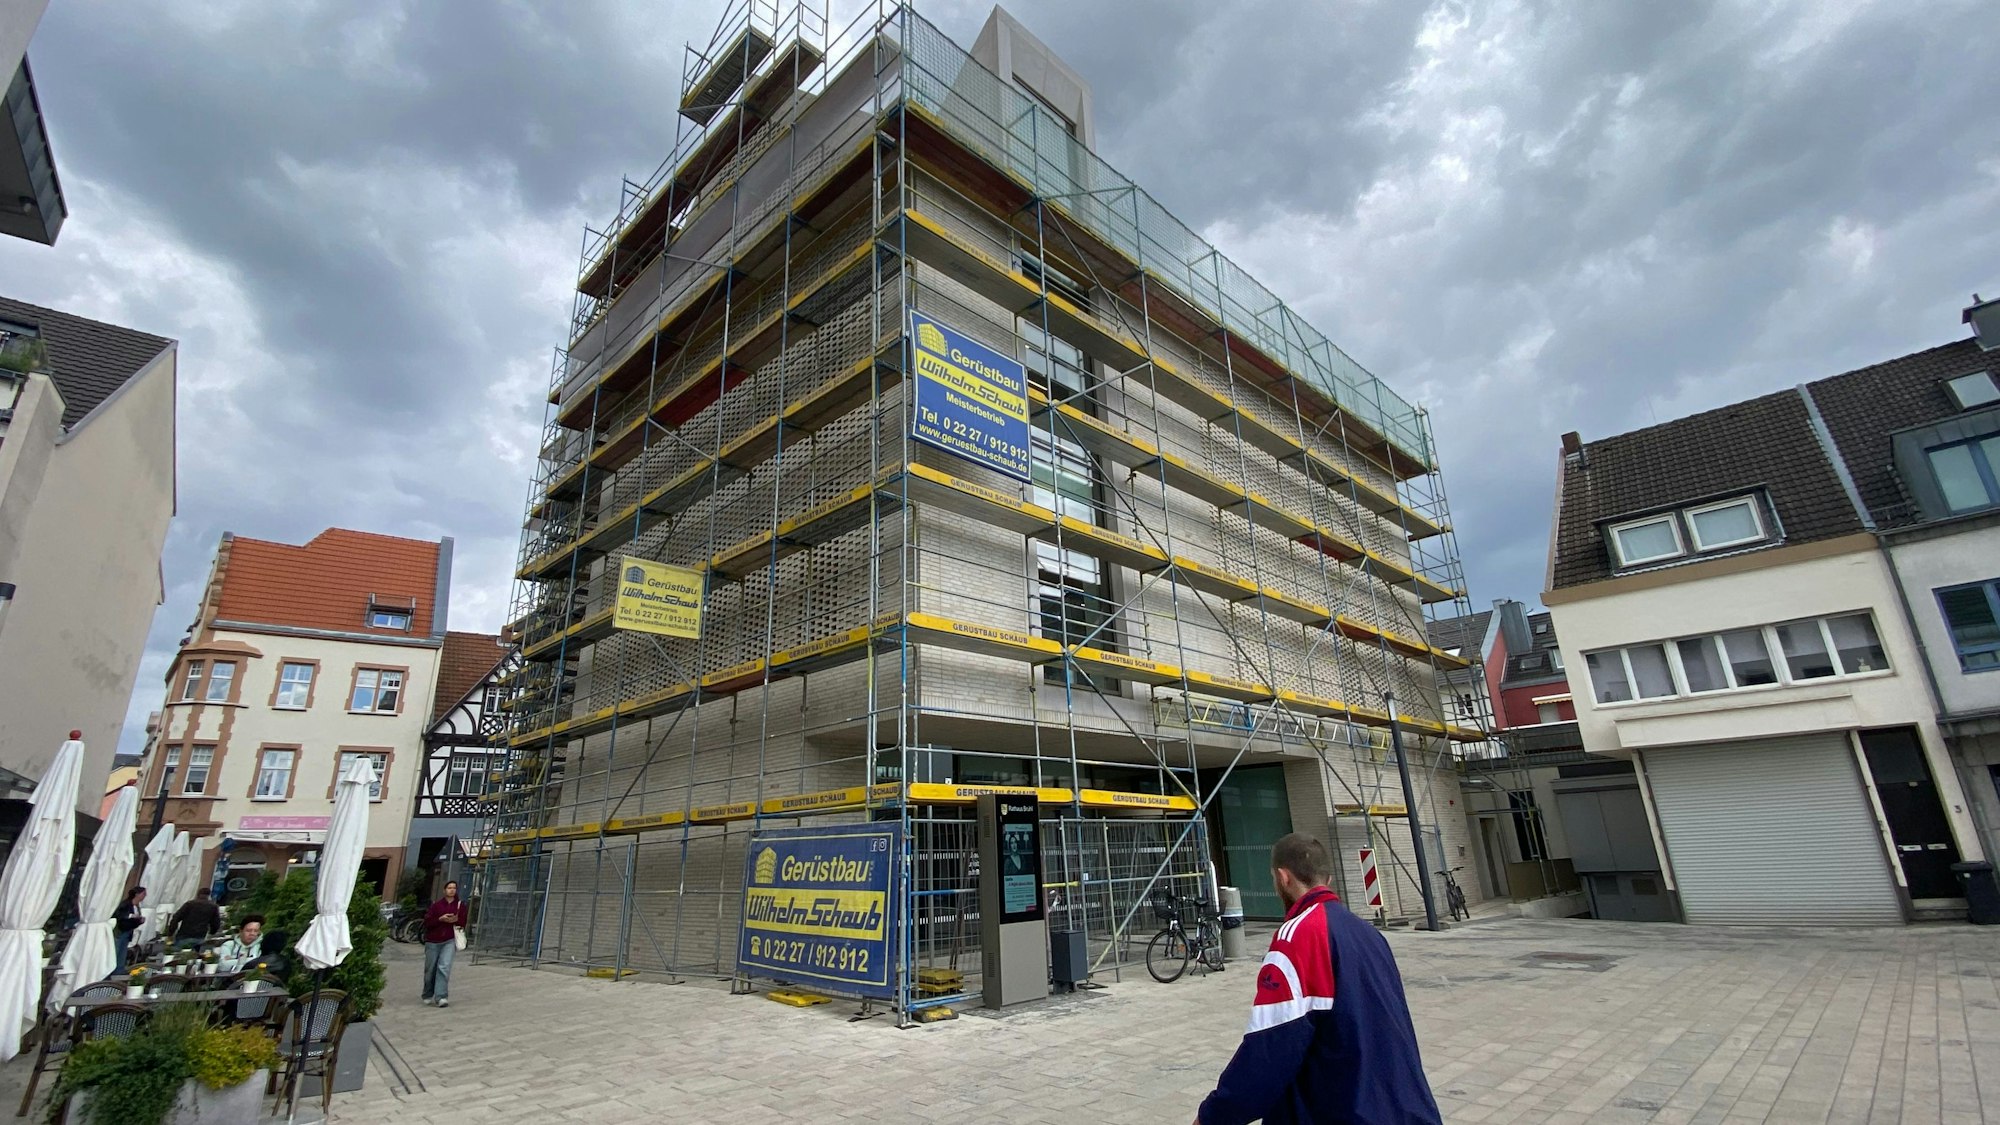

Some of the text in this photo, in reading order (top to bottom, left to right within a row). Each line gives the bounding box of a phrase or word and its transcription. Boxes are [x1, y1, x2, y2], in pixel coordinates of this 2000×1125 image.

[950, 348, 1019, 392] Gerüstbau
[945, 391, 1006, 427] Meisterbetrieb
[921, 405, 1028, 462] Tel. 0 22 27 / 912 912
[919, 423, 1028, 473] www.geruestbau-schaub.de
[647, 578, 698, 595] Gerüstbau
[642, 610, 652, 619] 22
[653, 612, 663, 620] 27
[664, 612, 668, 620] /
[668, 614, 682, 623] 912
[683, 617, 697, 626] 912
[876, 612, 900, 626] SCHAUB
[824, 634, 850, 649] SCHAUB
[999, 632, 1029, 645] SCHAUB
[820, 792, 847, 803] SCHAUB
[872, 785, 898, 796] SCHAUB
[1148, 796, 1170, 806] SCHAUB
[1954, 804, 1962, 814] 3
[781, 854, 870, 883] Gerüstbau
[764, 938, 870, 973] 0 22 27 / 912 912
